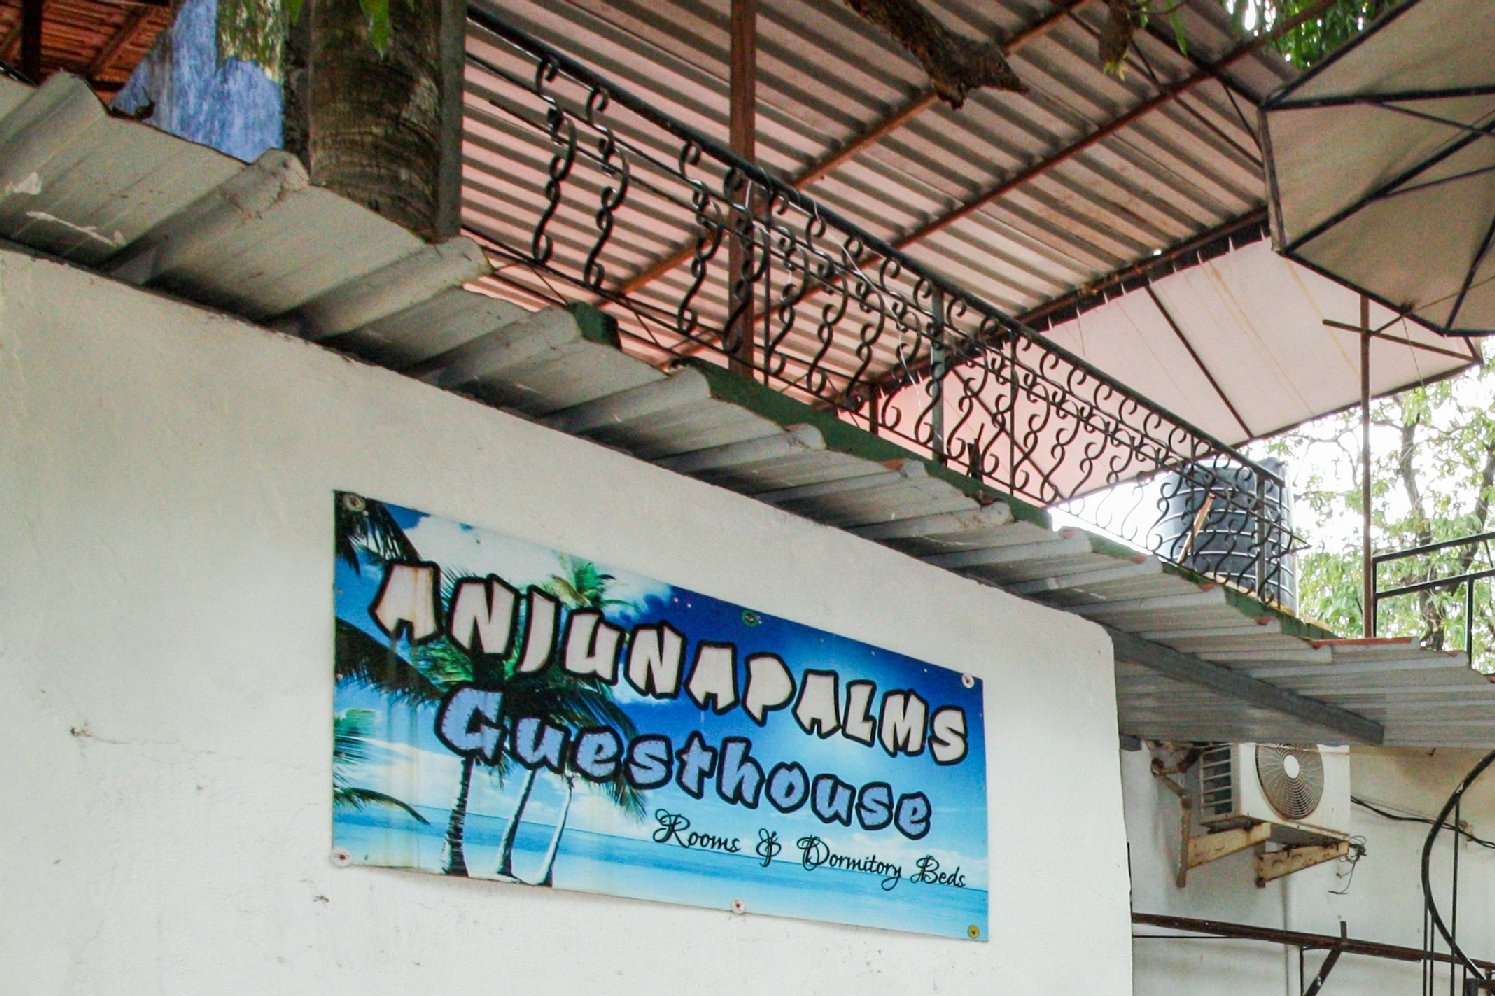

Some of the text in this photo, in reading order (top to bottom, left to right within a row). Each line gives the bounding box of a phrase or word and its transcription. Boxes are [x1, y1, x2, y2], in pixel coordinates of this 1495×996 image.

[436, 687, 932, 840] Guesthouse
[653, 809, 967, 891] Rooms & Dormitory Beds
